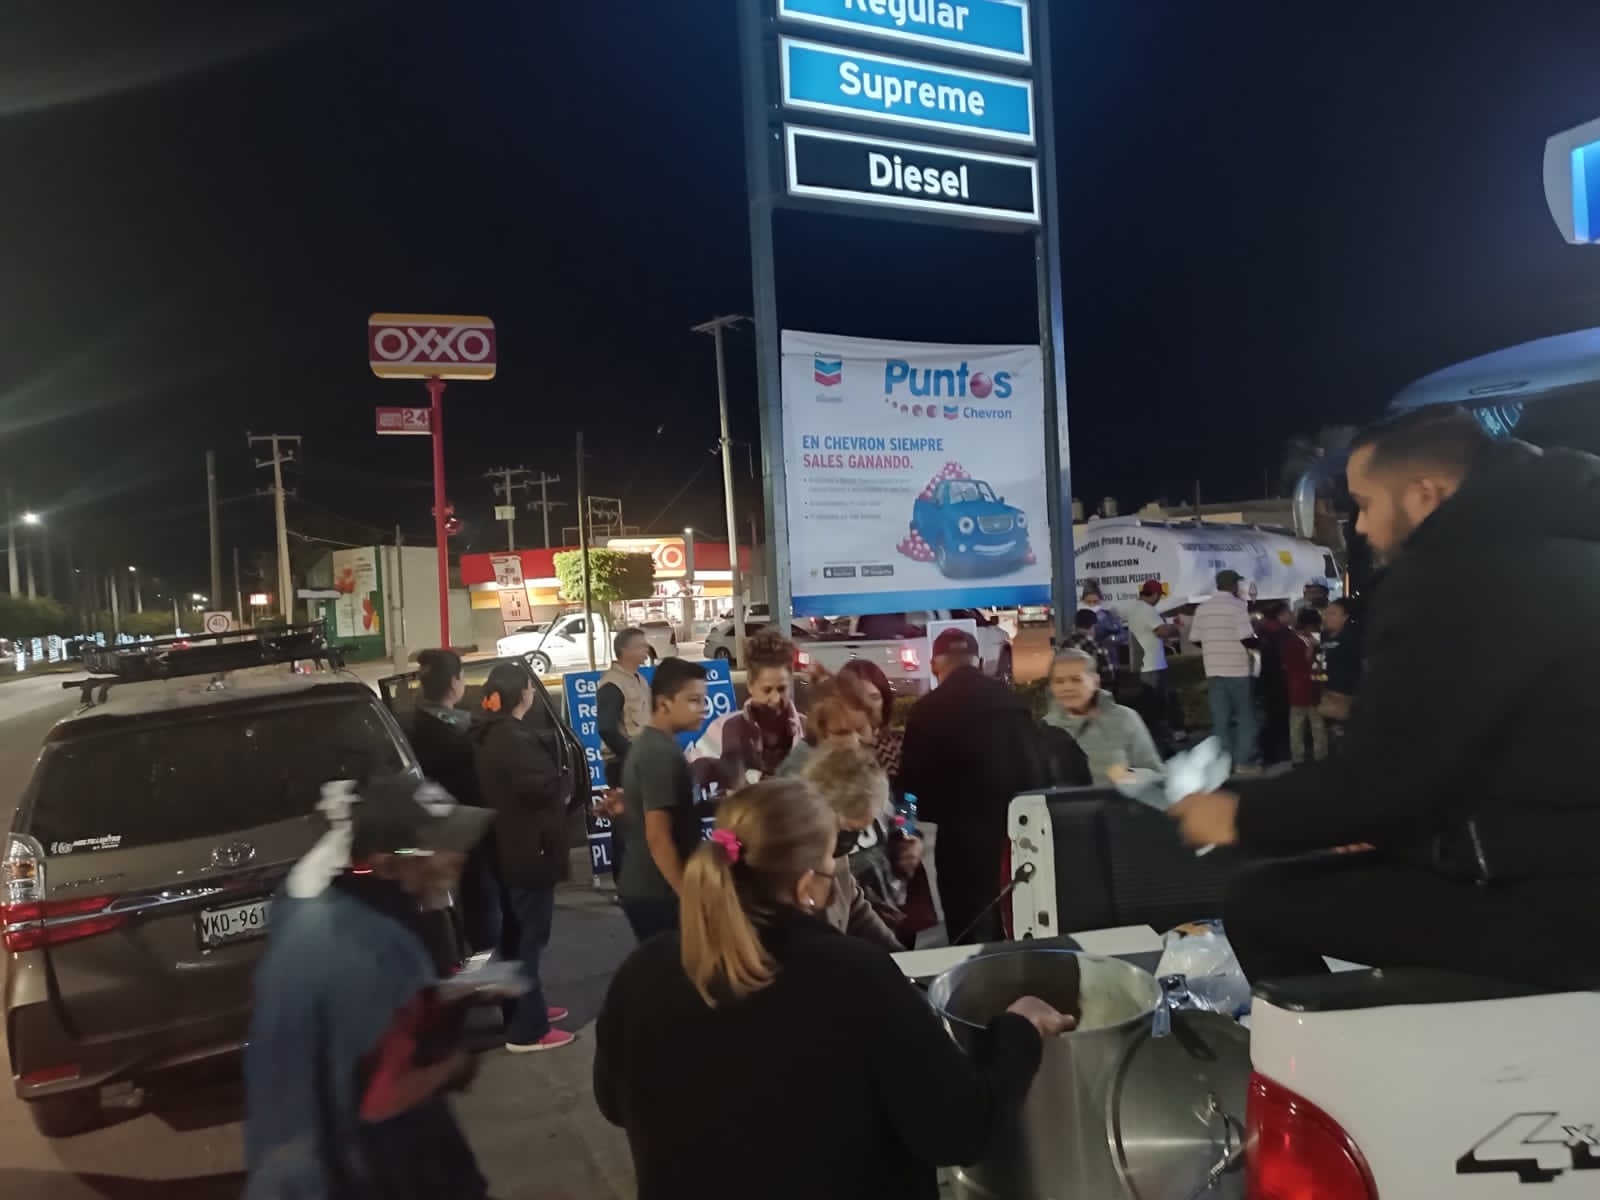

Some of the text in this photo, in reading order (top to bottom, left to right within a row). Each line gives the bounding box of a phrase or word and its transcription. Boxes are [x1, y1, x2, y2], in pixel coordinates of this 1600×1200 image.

[839, 61, 985, 116] Supreme
[868, 151, 969, 198] Diesel
[374, 327, 491, 362] OXXO
[404, 409, 428, 425] 24
[963, 406, 1012, 419] Chevron
[802, 434, 945, 452] EN CHEVRON SIEMPRE
[803, 453, 914, 470] SALES GANANDO.
[581, 721, 596, 735] 87
